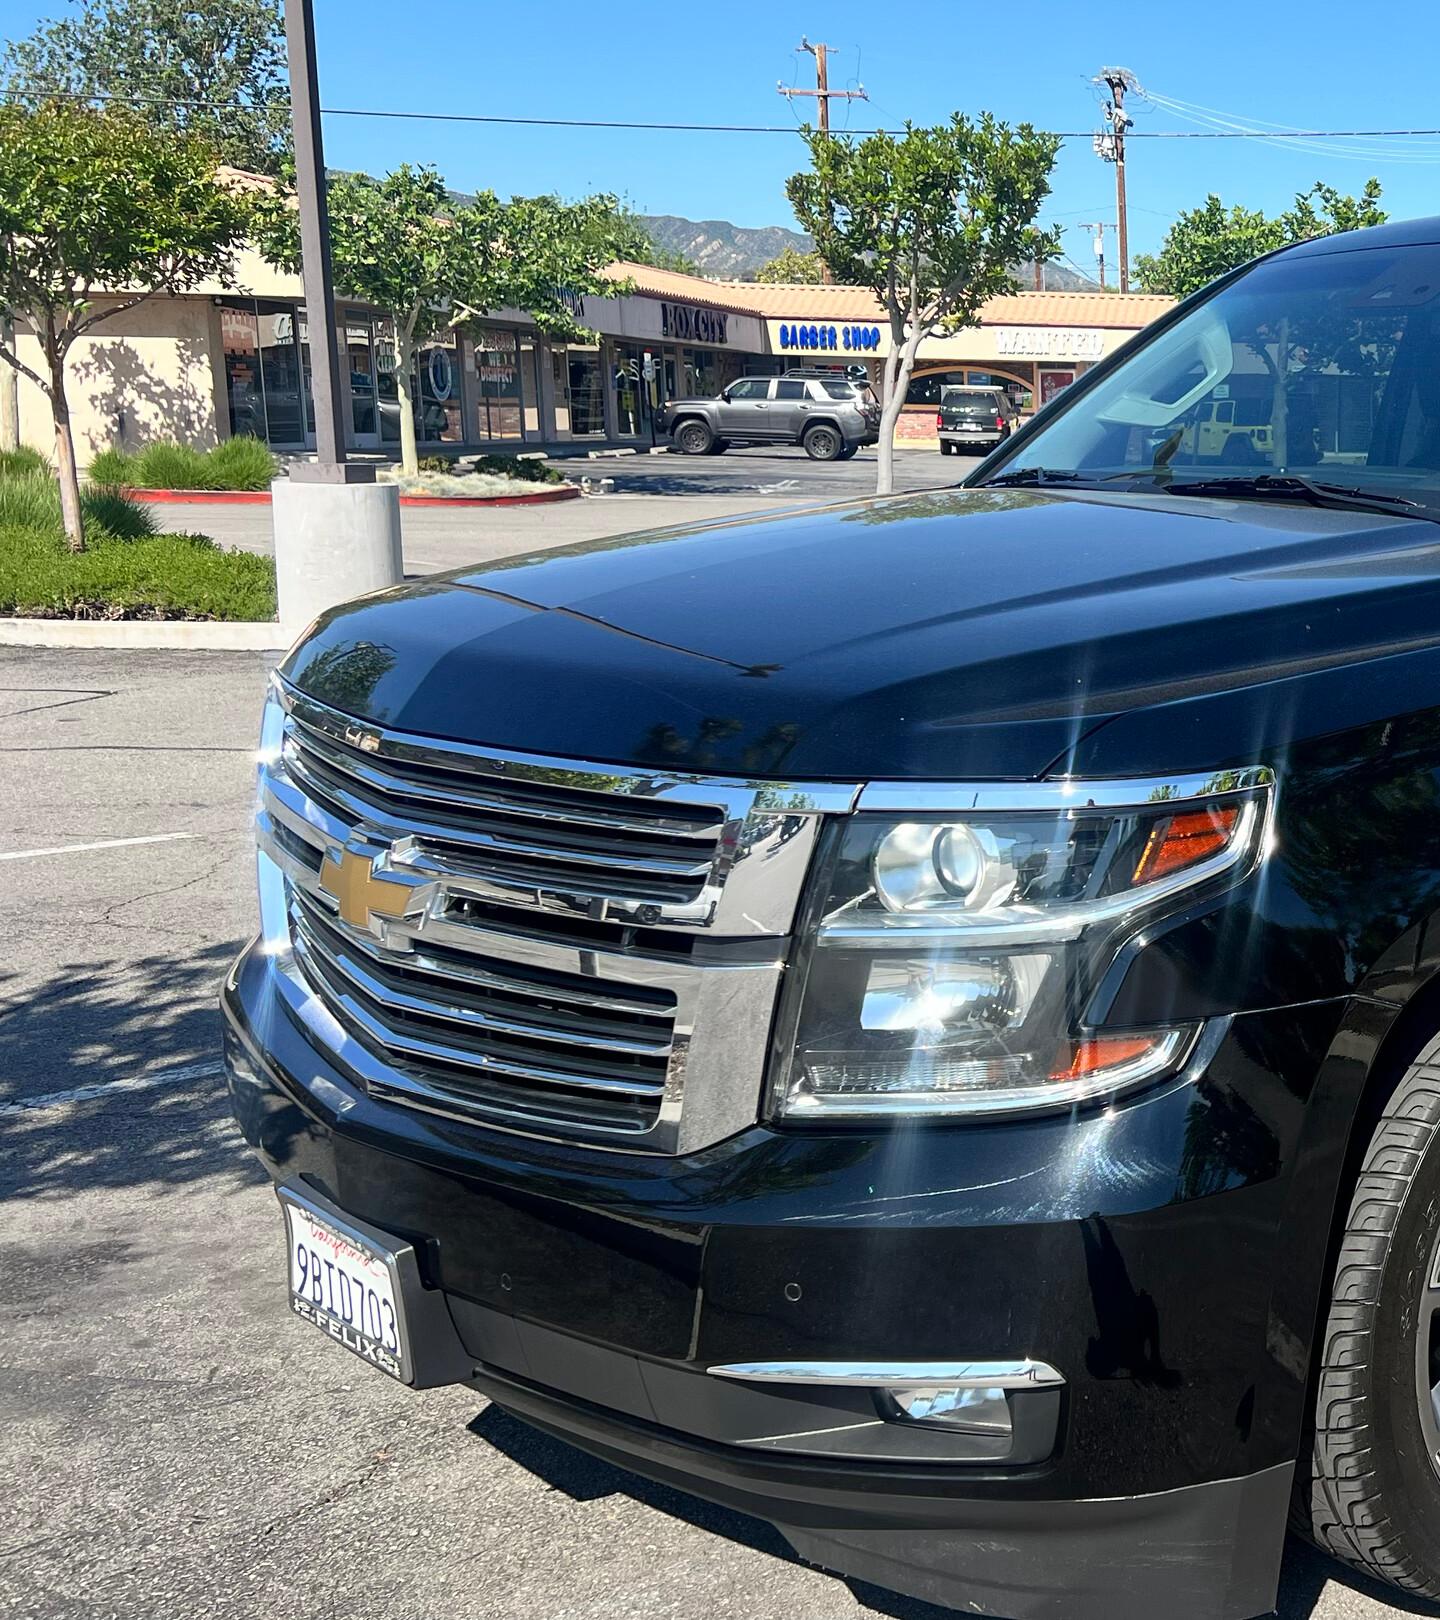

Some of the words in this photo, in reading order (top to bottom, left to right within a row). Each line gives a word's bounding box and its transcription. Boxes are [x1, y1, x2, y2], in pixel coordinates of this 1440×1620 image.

[661, 303, 696, 339] BOX
[695, 310, 728, 344] CITY
[780, 324, 838, 350] BARBER
[843, 326, 881, 352] SHOP
[994, 331, 1104, 356] WANTED
[297, 1242, 398, 1354] 9BID703
[316, 1313, 378, 1361] FELIX
